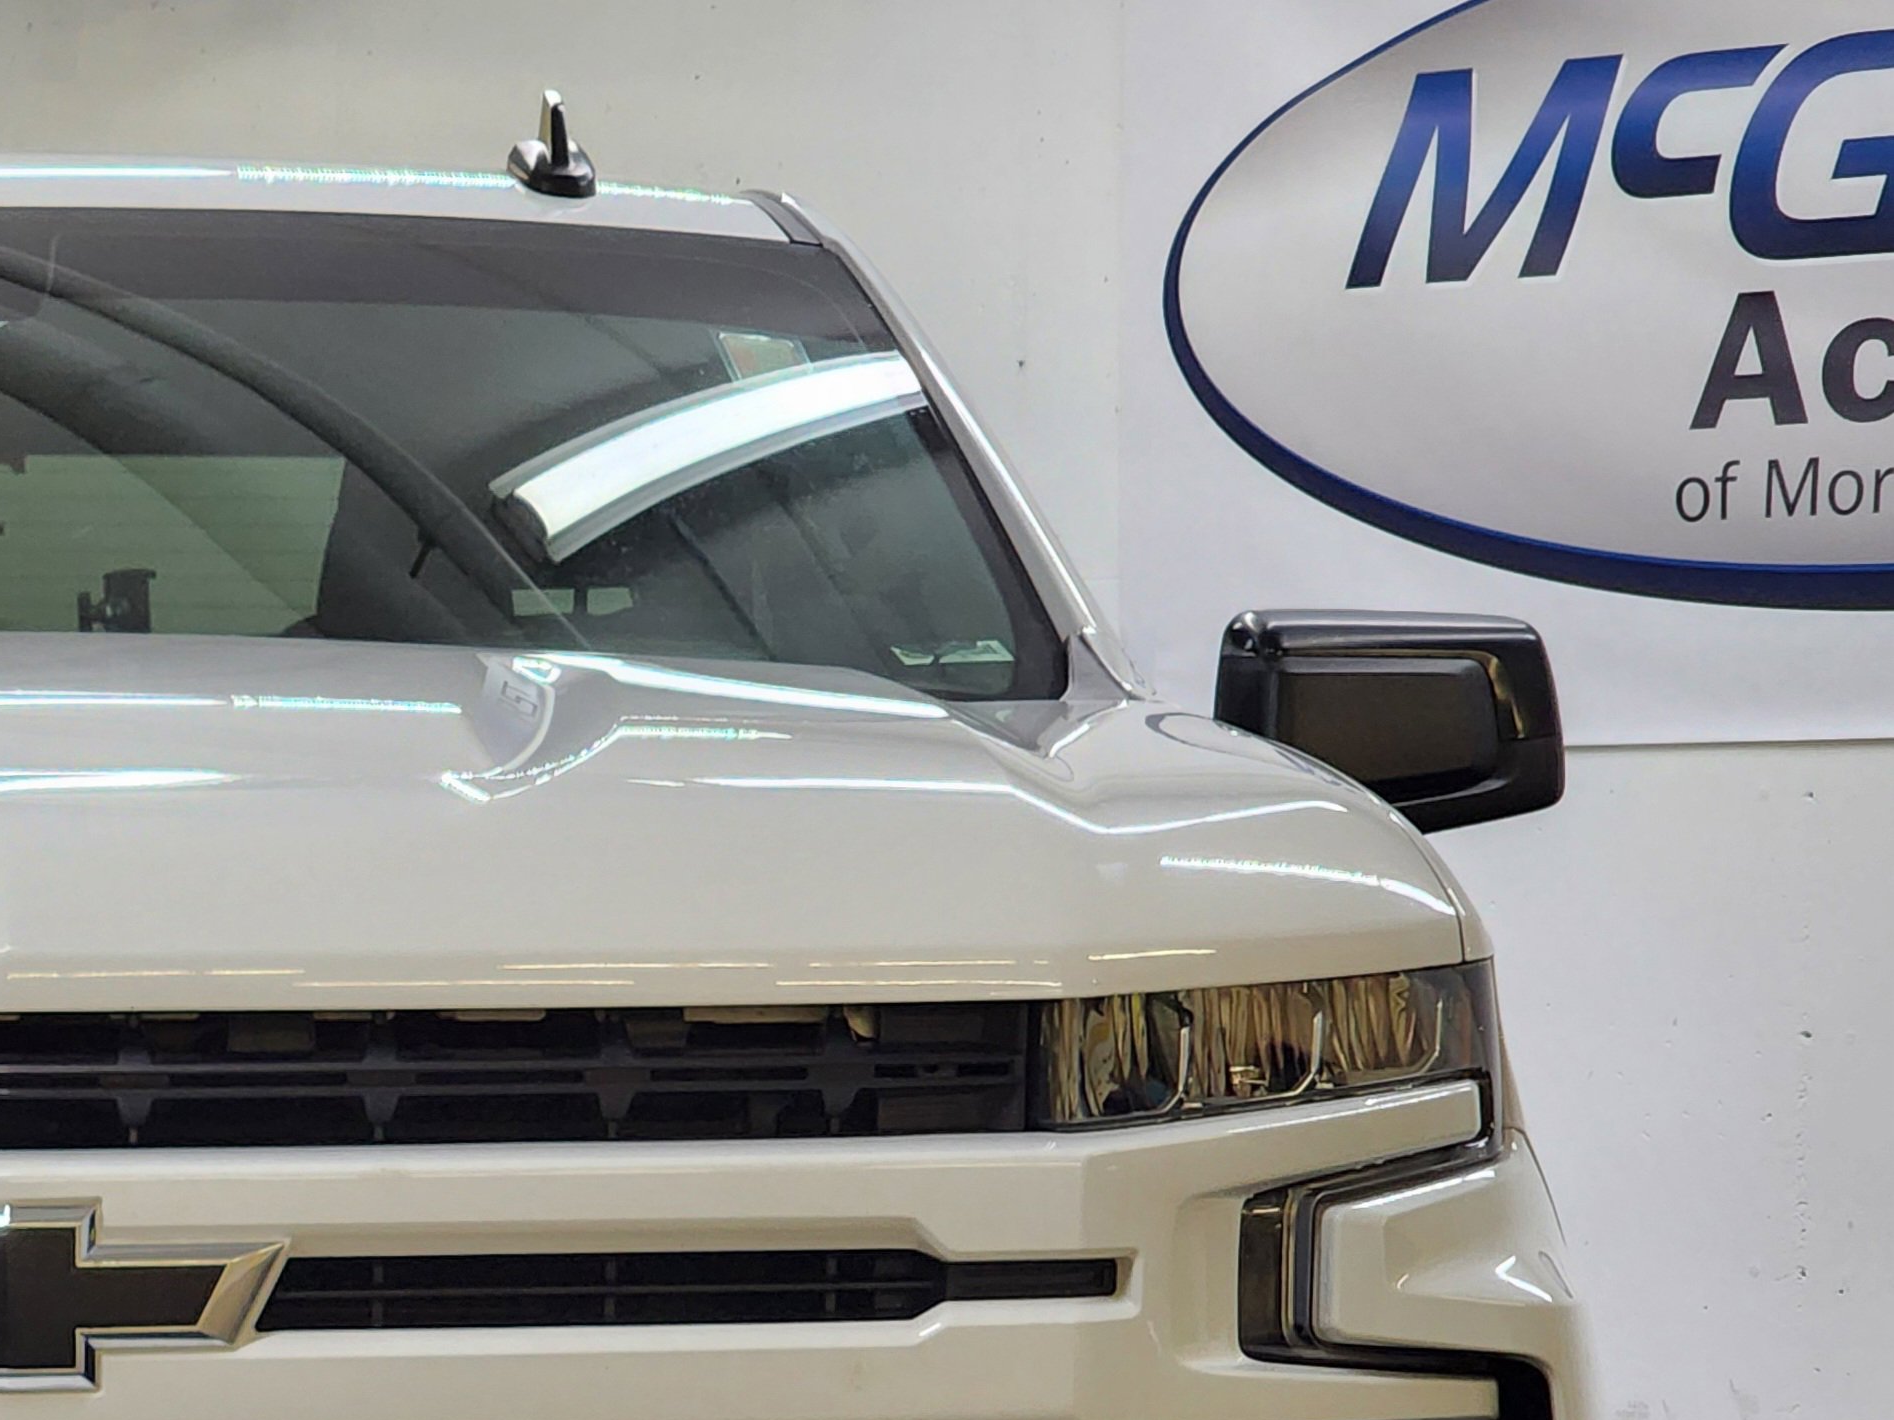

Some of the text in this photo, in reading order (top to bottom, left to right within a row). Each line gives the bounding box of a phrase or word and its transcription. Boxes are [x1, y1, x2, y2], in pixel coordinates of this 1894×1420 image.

[1689, 290, 1894, 430] Ac
[1675, 457, 1894, 522] of Mor
